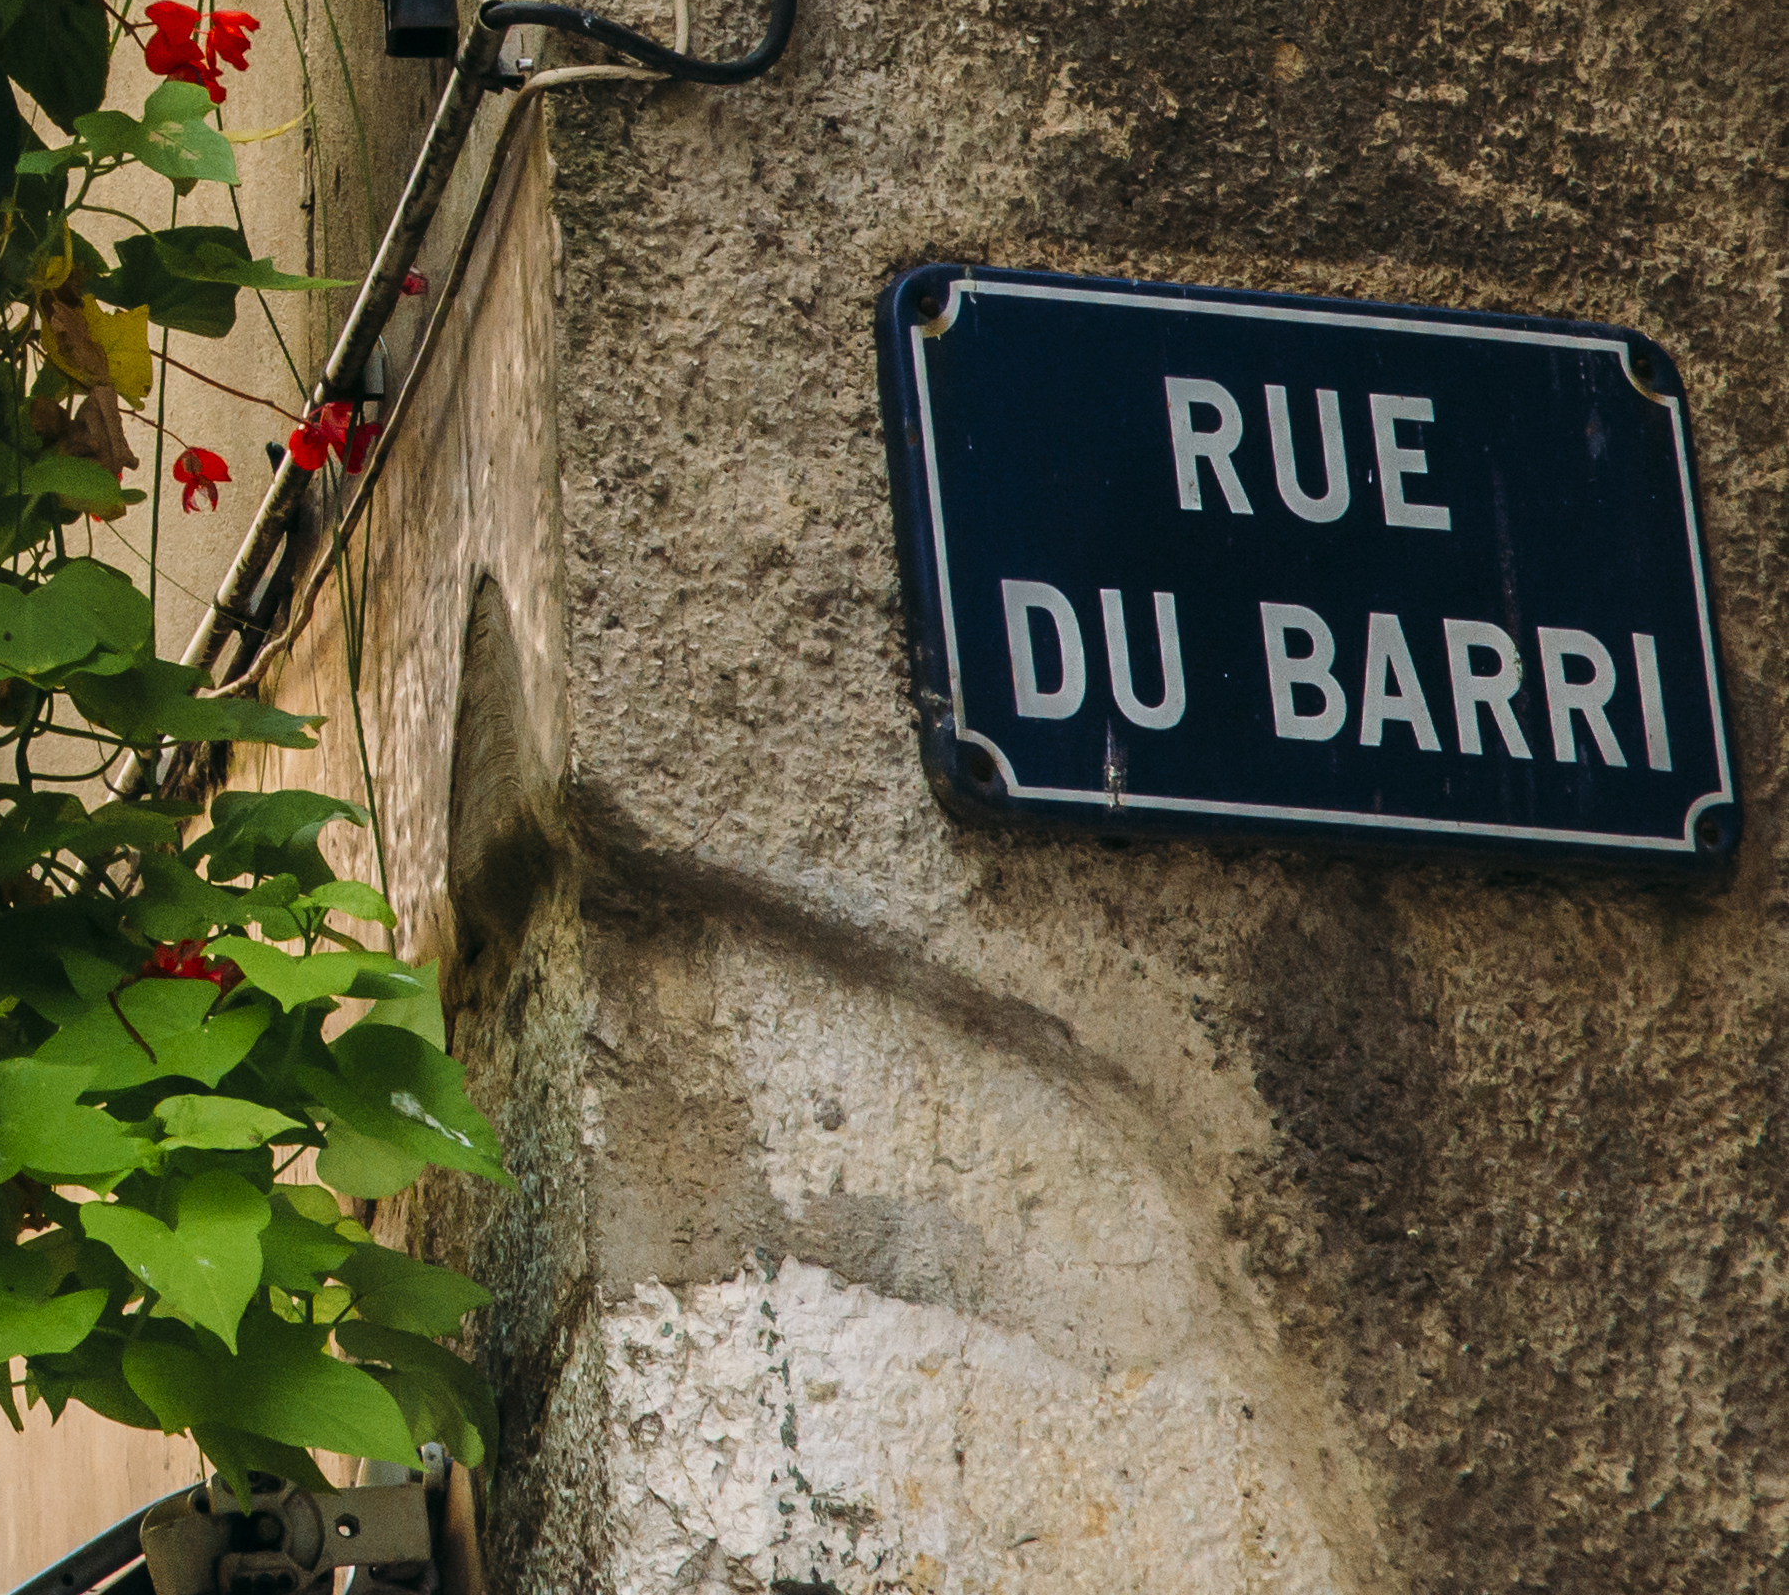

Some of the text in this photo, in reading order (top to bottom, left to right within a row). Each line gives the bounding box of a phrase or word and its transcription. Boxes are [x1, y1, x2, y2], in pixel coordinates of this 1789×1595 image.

[1165, 376, 1451, 531] RUE
[1001, 579, 1672, 772] DU BARRI
